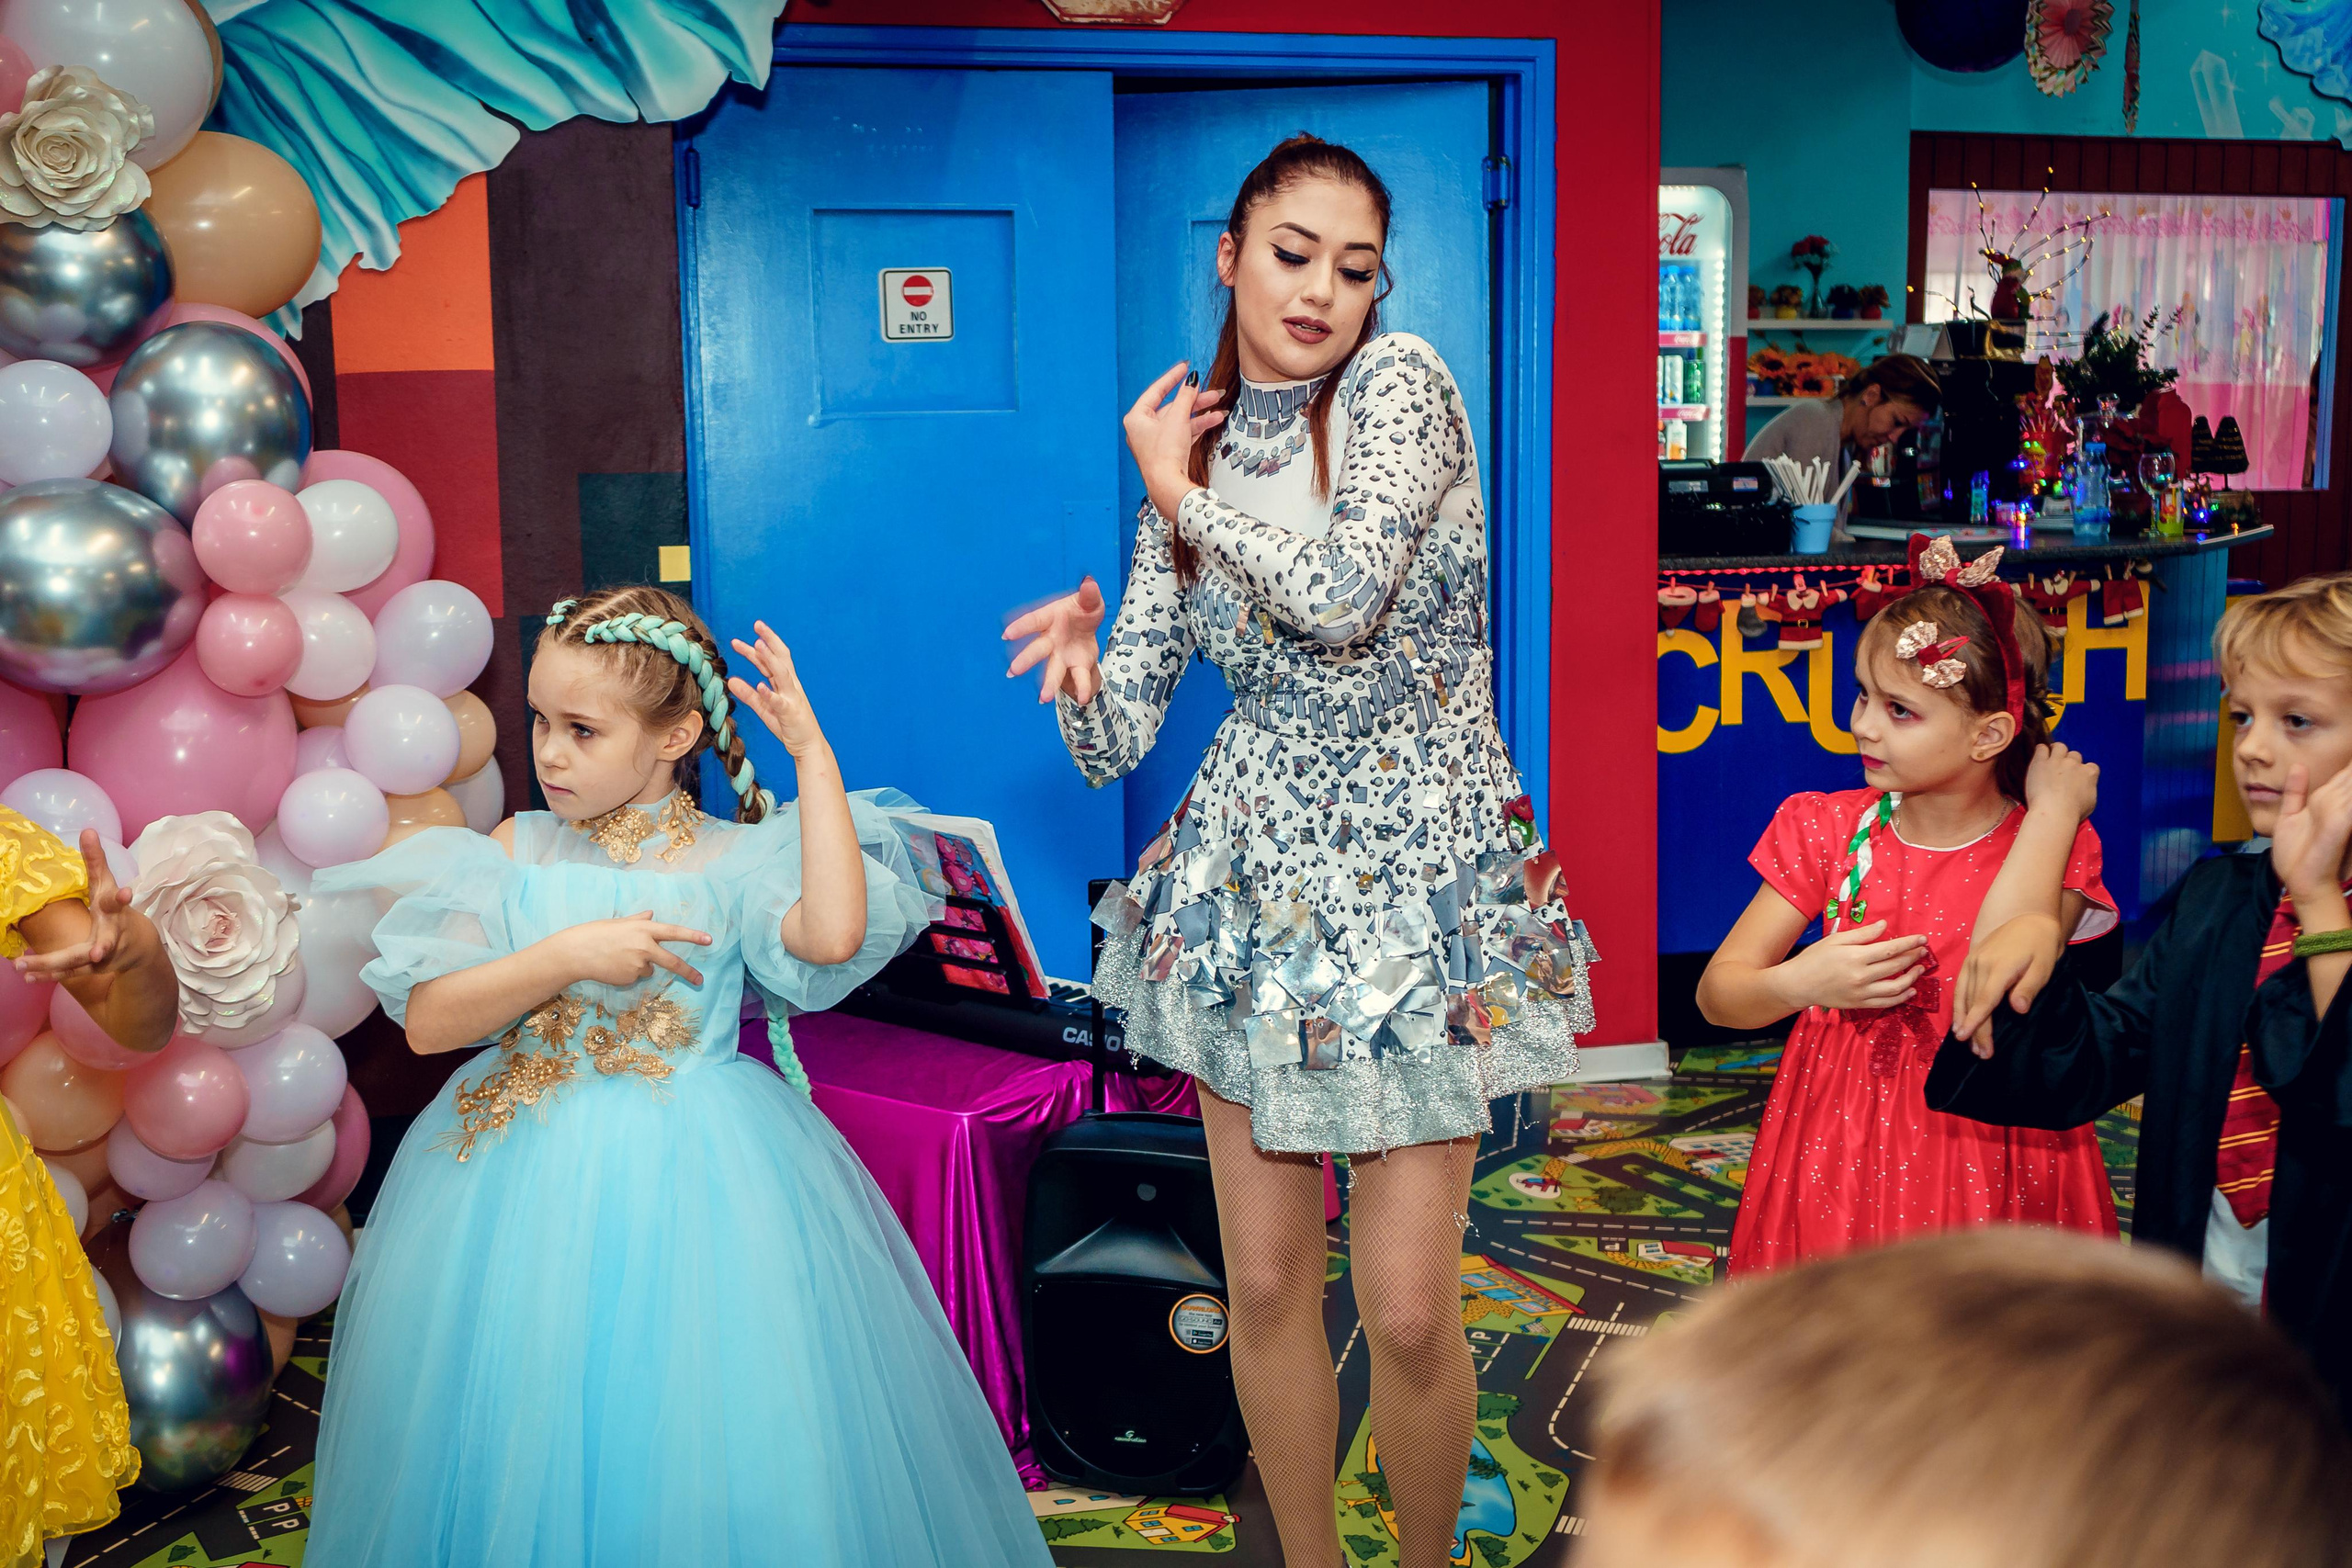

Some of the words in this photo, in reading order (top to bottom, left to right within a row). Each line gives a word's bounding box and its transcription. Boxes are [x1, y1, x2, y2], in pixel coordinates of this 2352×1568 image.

[1659, 212, 1705, 255] ola
[910, 311, 927, 321] NO
[899, 323, 939, 333] ENTRY
[1062, 1026, 1122, 1052] CAO
